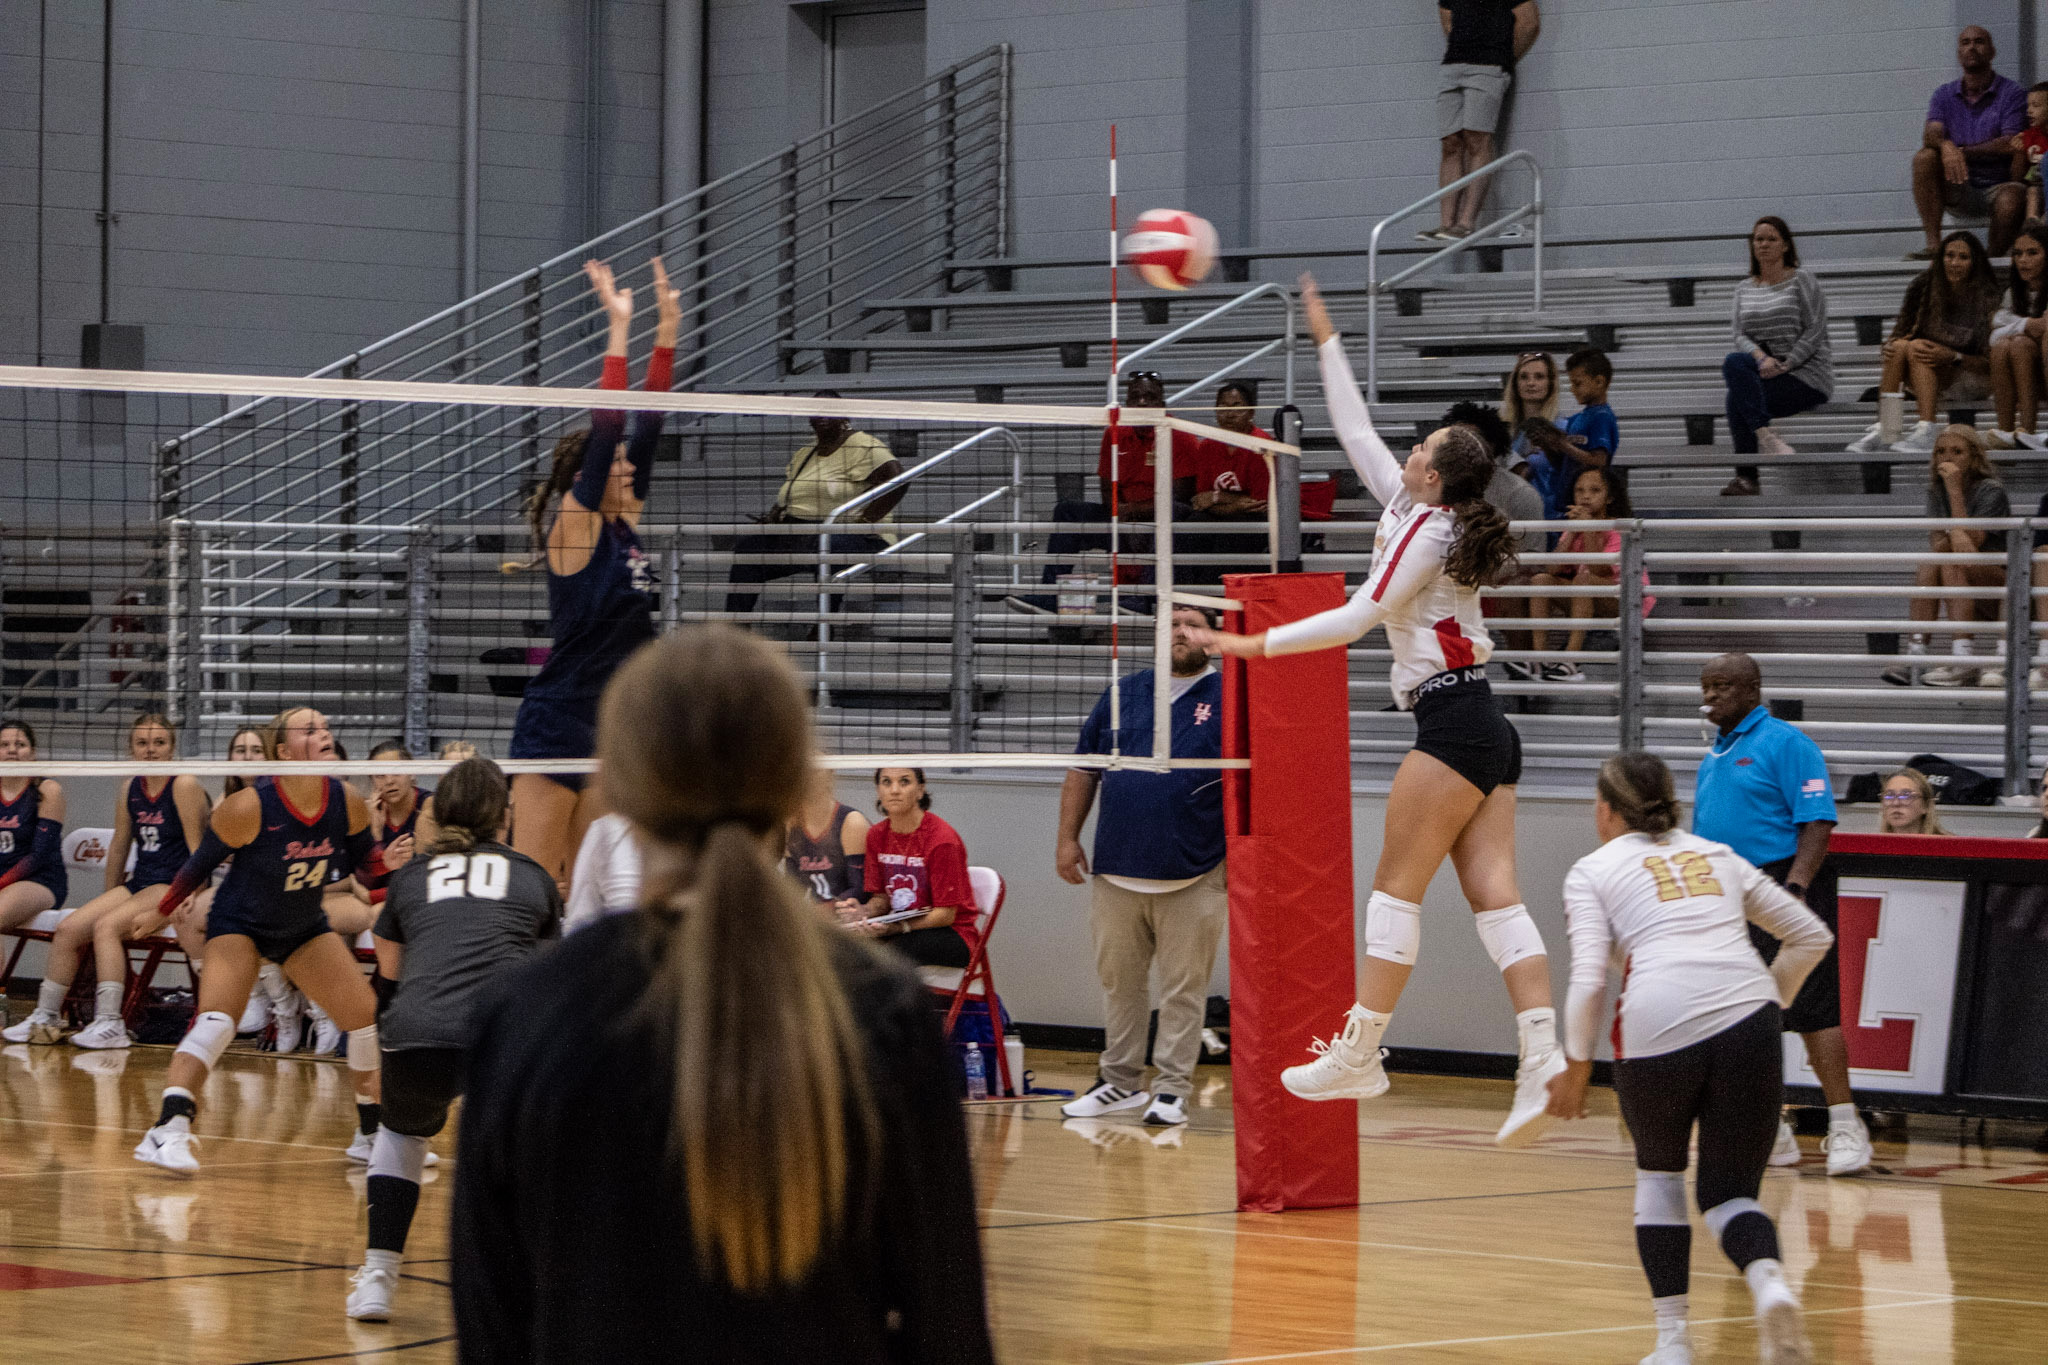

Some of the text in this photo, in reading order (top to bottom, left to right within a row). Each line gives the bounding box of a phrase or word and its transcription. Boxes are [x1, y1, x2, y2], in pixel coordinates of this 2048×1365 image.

[1419, 674, 1458, 698] PRO
[284, 859, 328, 891] 24
[426, 852, 509, 903] 20
[1643, 851, 1724, 902] 12
